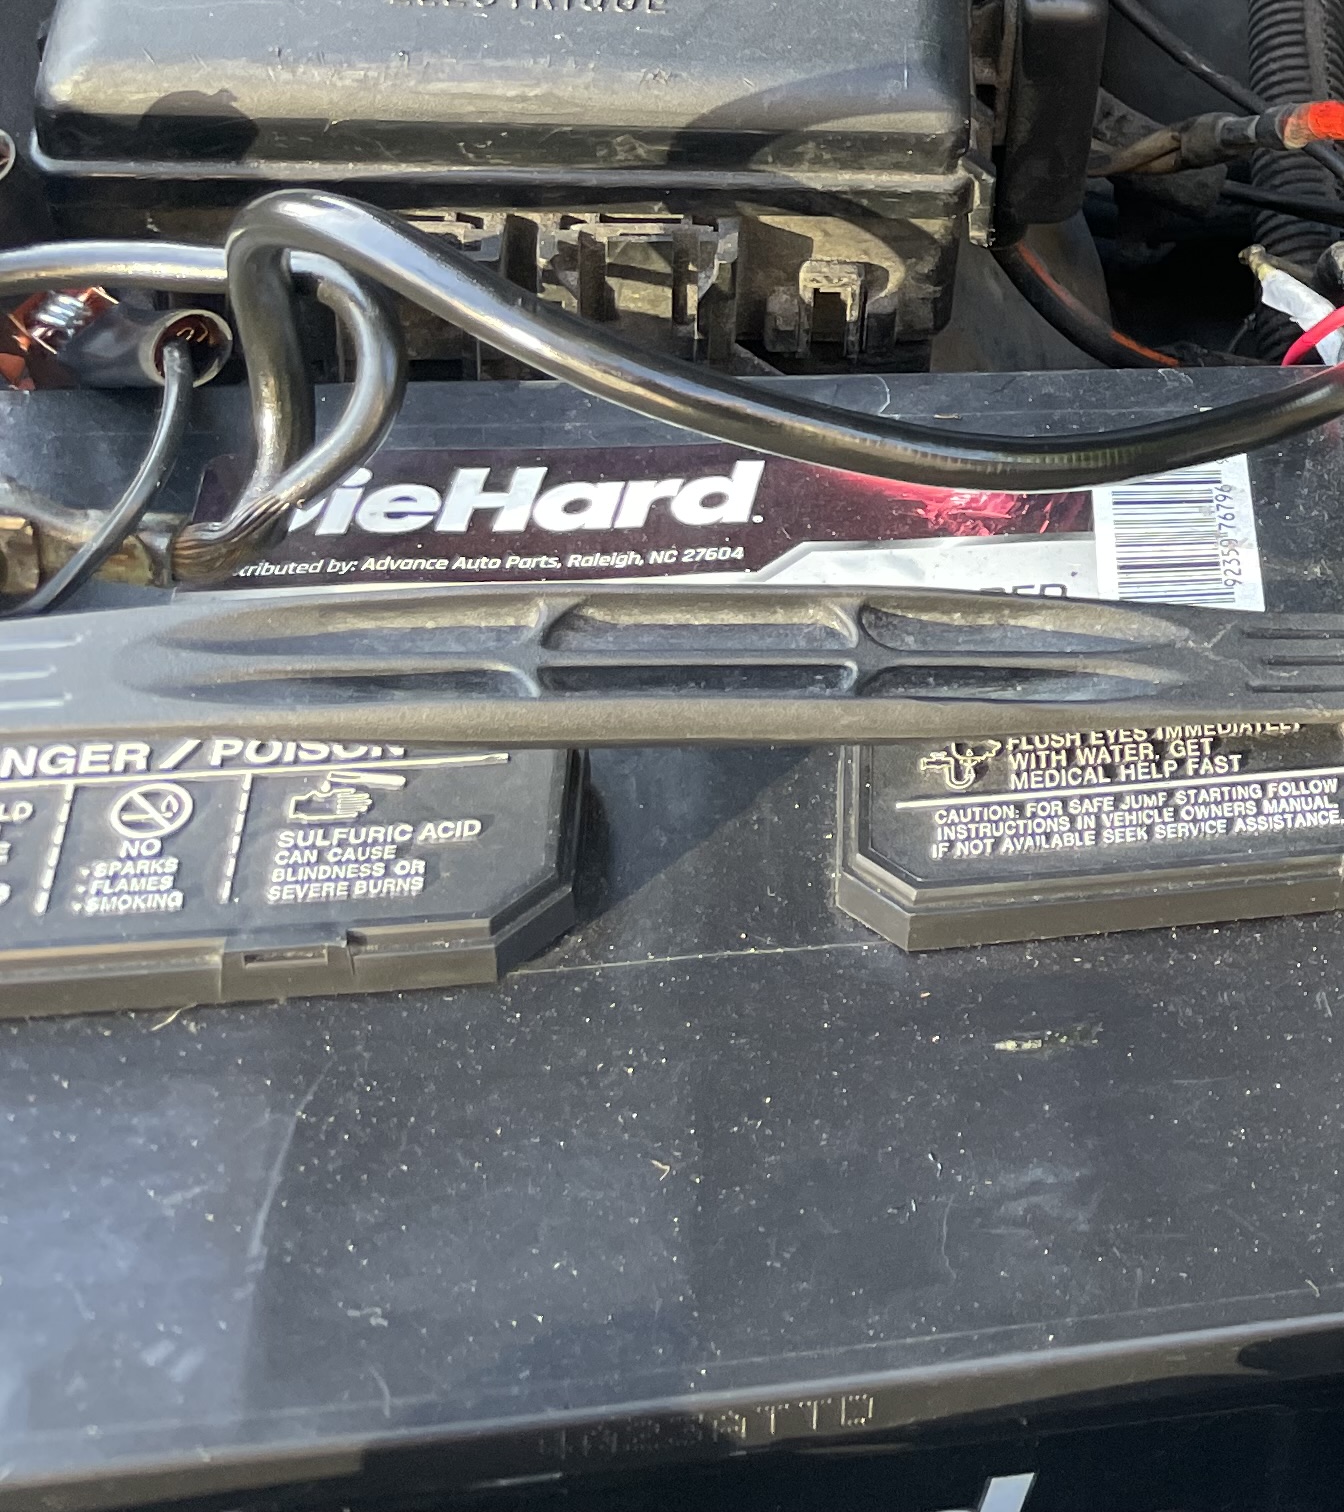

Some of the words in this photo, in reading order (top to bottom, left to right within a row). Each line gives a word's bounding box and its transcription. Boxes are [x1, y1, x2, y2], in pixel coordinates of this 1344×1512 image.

[326, 559, 359, 576] by:
[360, 555, 450, 571] Advance
[451, 554, 502, 571] Auto
[505, 554, 563, 570] Parts,
[567, 550, 645, 569] Raleigh,
[648, 549, 678, 564] NC
[681, 546, 745, 563] 27604
[1009, 750, 1068, 770] WITH
[1168, 736, 1215, 758] GET
[1010, 764, 1112, 791] MEDICAL
[1120, 759, 1178, 782] HELP
[1186, 753, 1243, 777] FAST
[934, 804, 1020, 825] CAUTION:
[1026, 799, 1064, 819] FOR
[1068, 795, 1116, 815] SAFE
[1175, 782, 1263, 807] STARTING
[1267, 777, 1339, 796] FOLLOW
[277, 823, 414, 848] SULFURIC
[418, 819, 482, 840] ACID
[937, 815, 1072, 841] INSTRUCTIONS
[1077, 813, 1097, 830] IN
[1101, 806, 1176, 828] VEHICLE
[1180, 800, 1258, 821] OWNERS
[119, 838, 163, 859] NO
[931, 842, 951, 860] IF
[956, 837, 996, 858] NOT
[1001, 829, 1097, 853] AVAILABLE
[1102, 826, 1149, 845] SEEK
[1154, 817, 1228, 840] SERVICE
[93, 856, 180, 879] SPARKS
[274, 849, 318, 865] CAN
[327, 844, 398, 862] CAUSE
[271, 862, 386, 882] BLINDNESS
[393, 859, 426, 874] OR
[89, 875, 175, 897] FLAMES
[267, 881, 350, 901] SEVERE
[353, 876, 425, 895] BURNS
[84, 890, 184, 915] SMOKING
